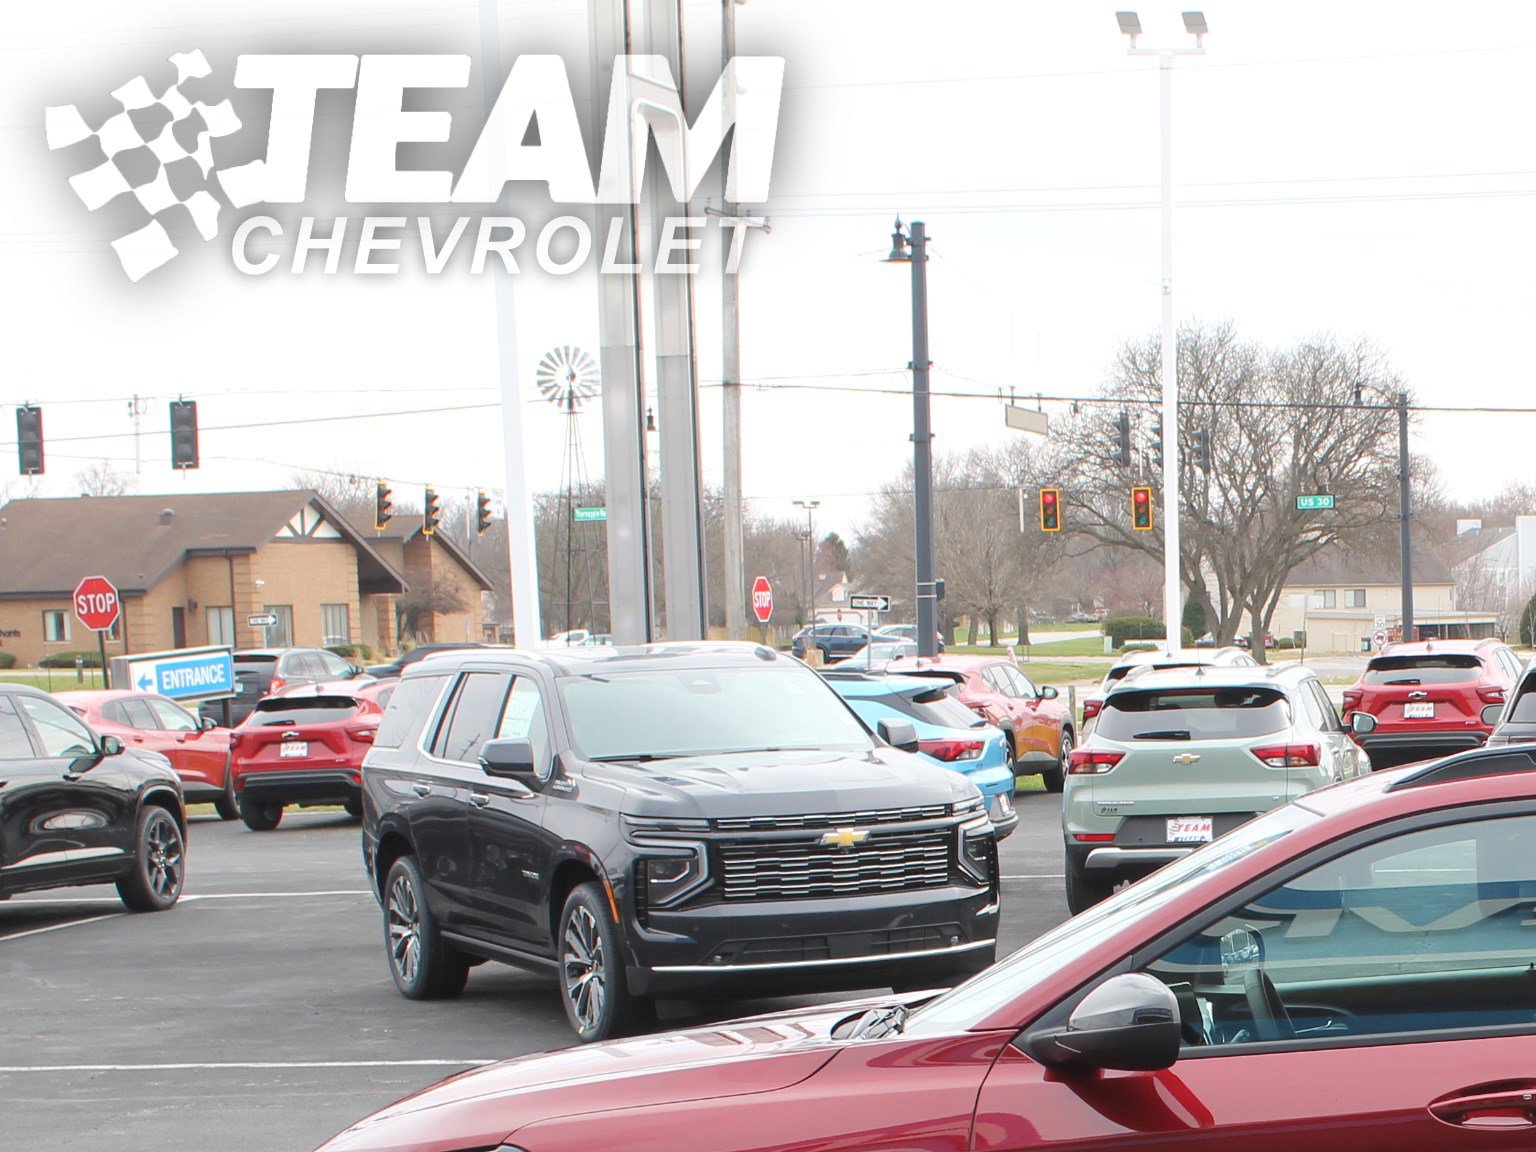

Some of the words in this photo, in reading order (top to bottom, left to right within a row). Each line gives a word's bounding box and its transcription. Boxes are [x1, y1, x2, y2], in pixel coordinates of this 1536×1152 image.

[1301, 498, 1315, 507] US
[1317, 497, 1330, 506] 30
[78, 594, 115, 615] STOP
[754, 591, 771, 608] STOP
[161, 663, 226, 690] ENTRANCE
[1176, 824, 1211, 832] TEAM
